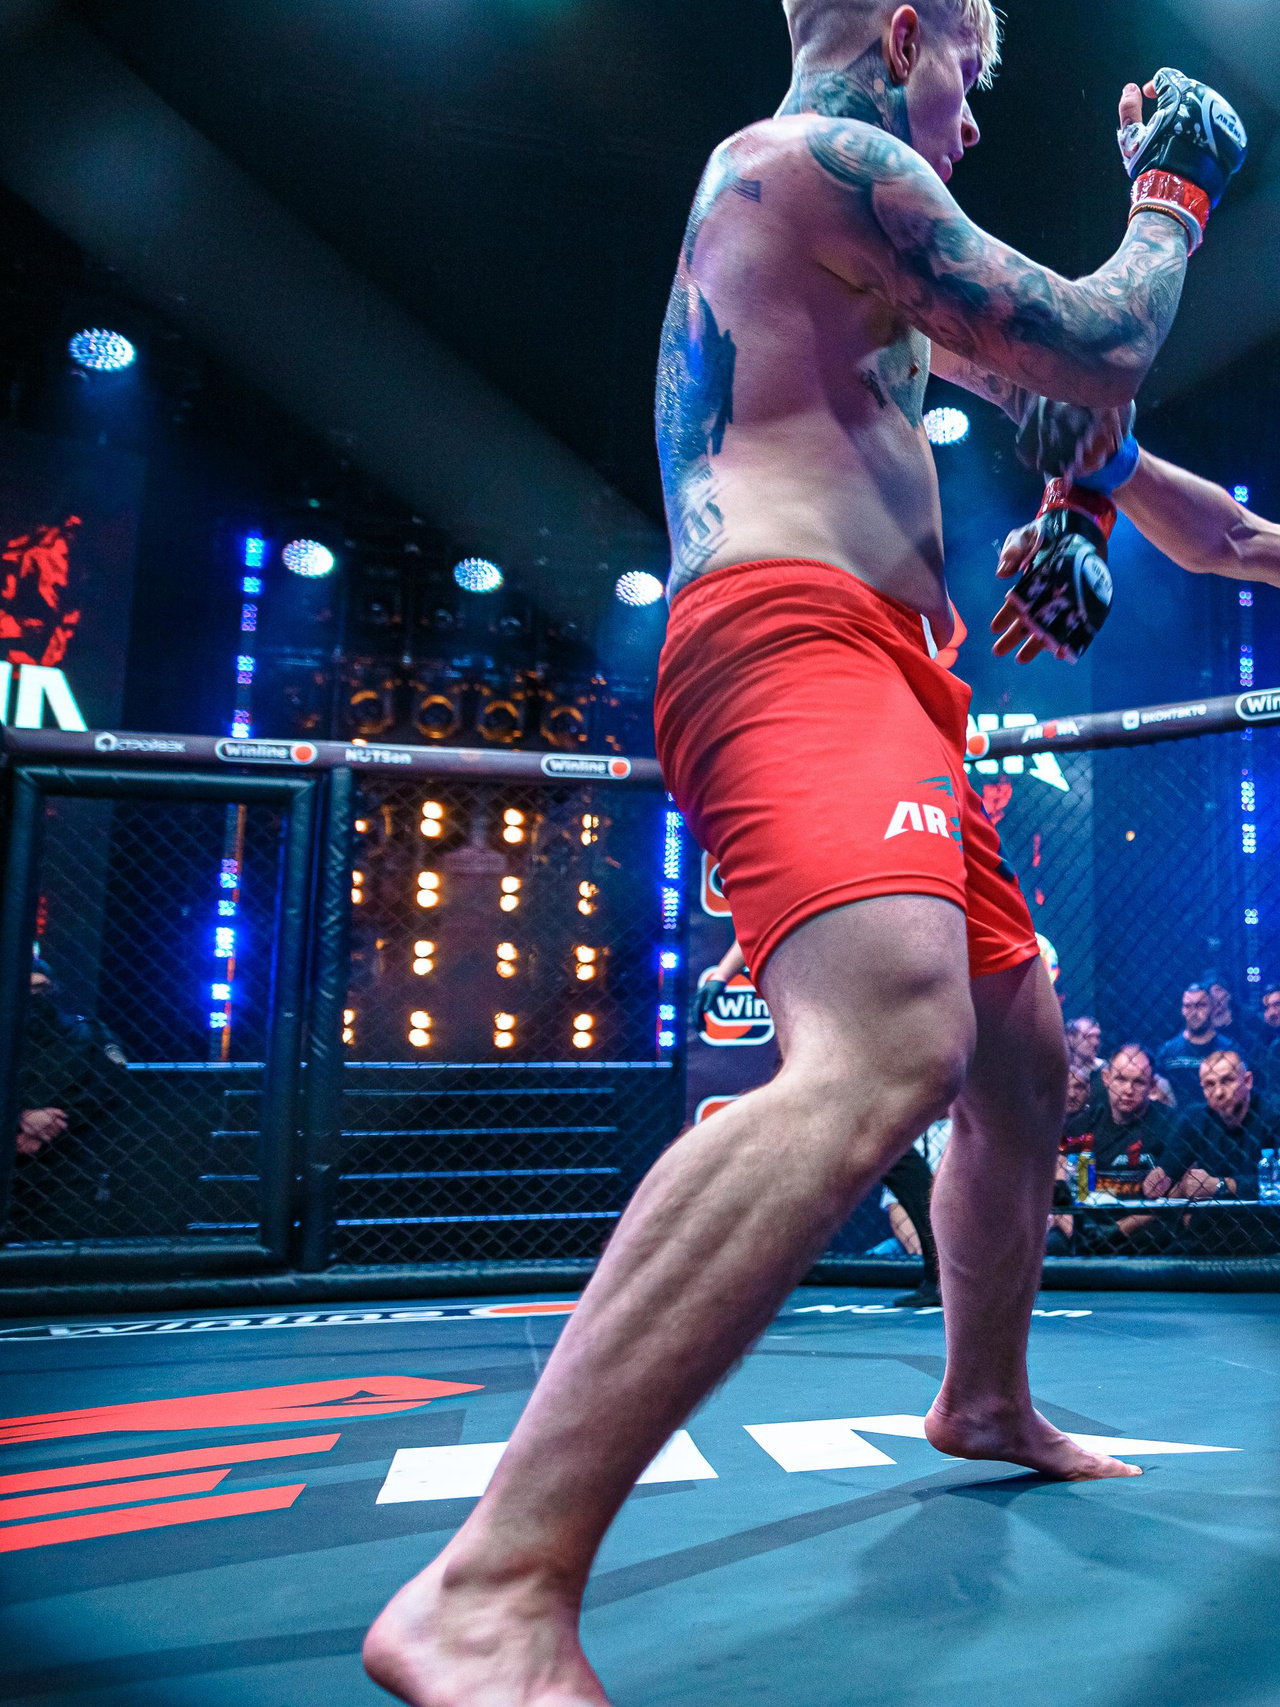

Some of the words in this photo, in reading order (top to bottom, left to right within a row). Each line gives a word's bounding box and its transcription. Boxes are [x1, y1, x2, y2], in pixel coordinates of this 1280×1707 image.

[224, 742, 289, 760] Winline
[549, 758, 607, 774] Winline
[717, 995, 770, 1018] Win
[50, 1310, 443, 1336] Winline
